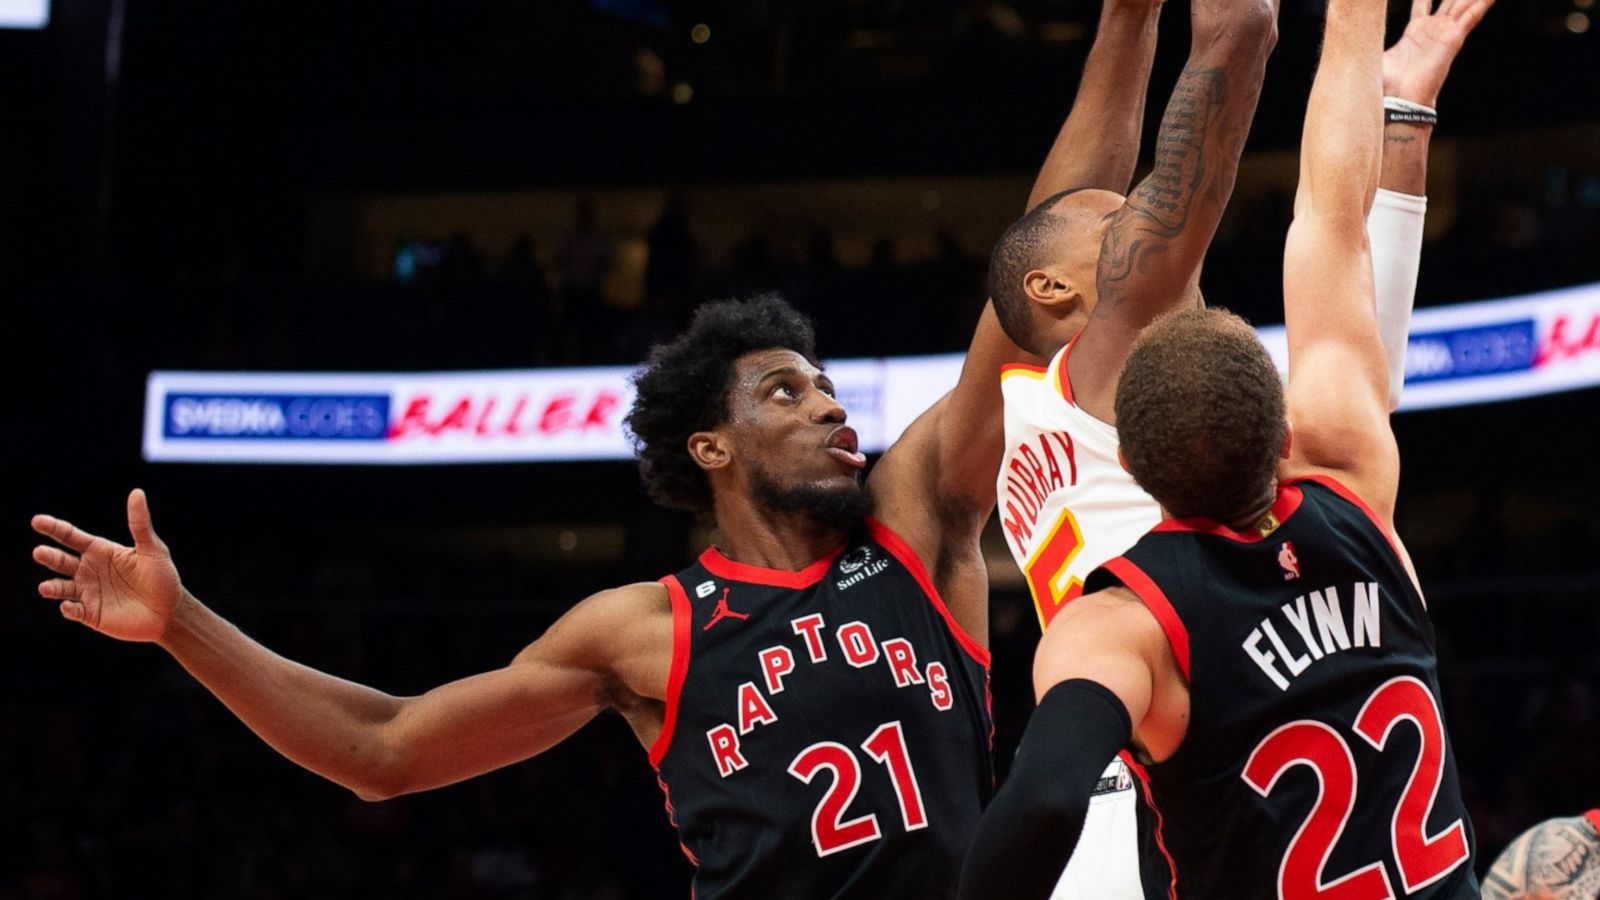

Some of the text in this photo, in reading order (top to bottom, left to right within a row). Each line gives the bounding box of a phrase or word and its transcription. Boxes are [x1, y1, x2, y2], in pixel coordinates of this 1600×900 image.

[389, 392, 619, 441] BALLER
[1004, 431, 1077, 557] MURRAY
[695, 580, 717, 598] 6
[836, 559, 889, 590] Sun Life
[1242, 582, 1381, 691] FLYNN
[706, 613, 953, 778] RAPTORS
[787, 720, 928, 857] 21
[1241, 675, 1470, 900] 22
